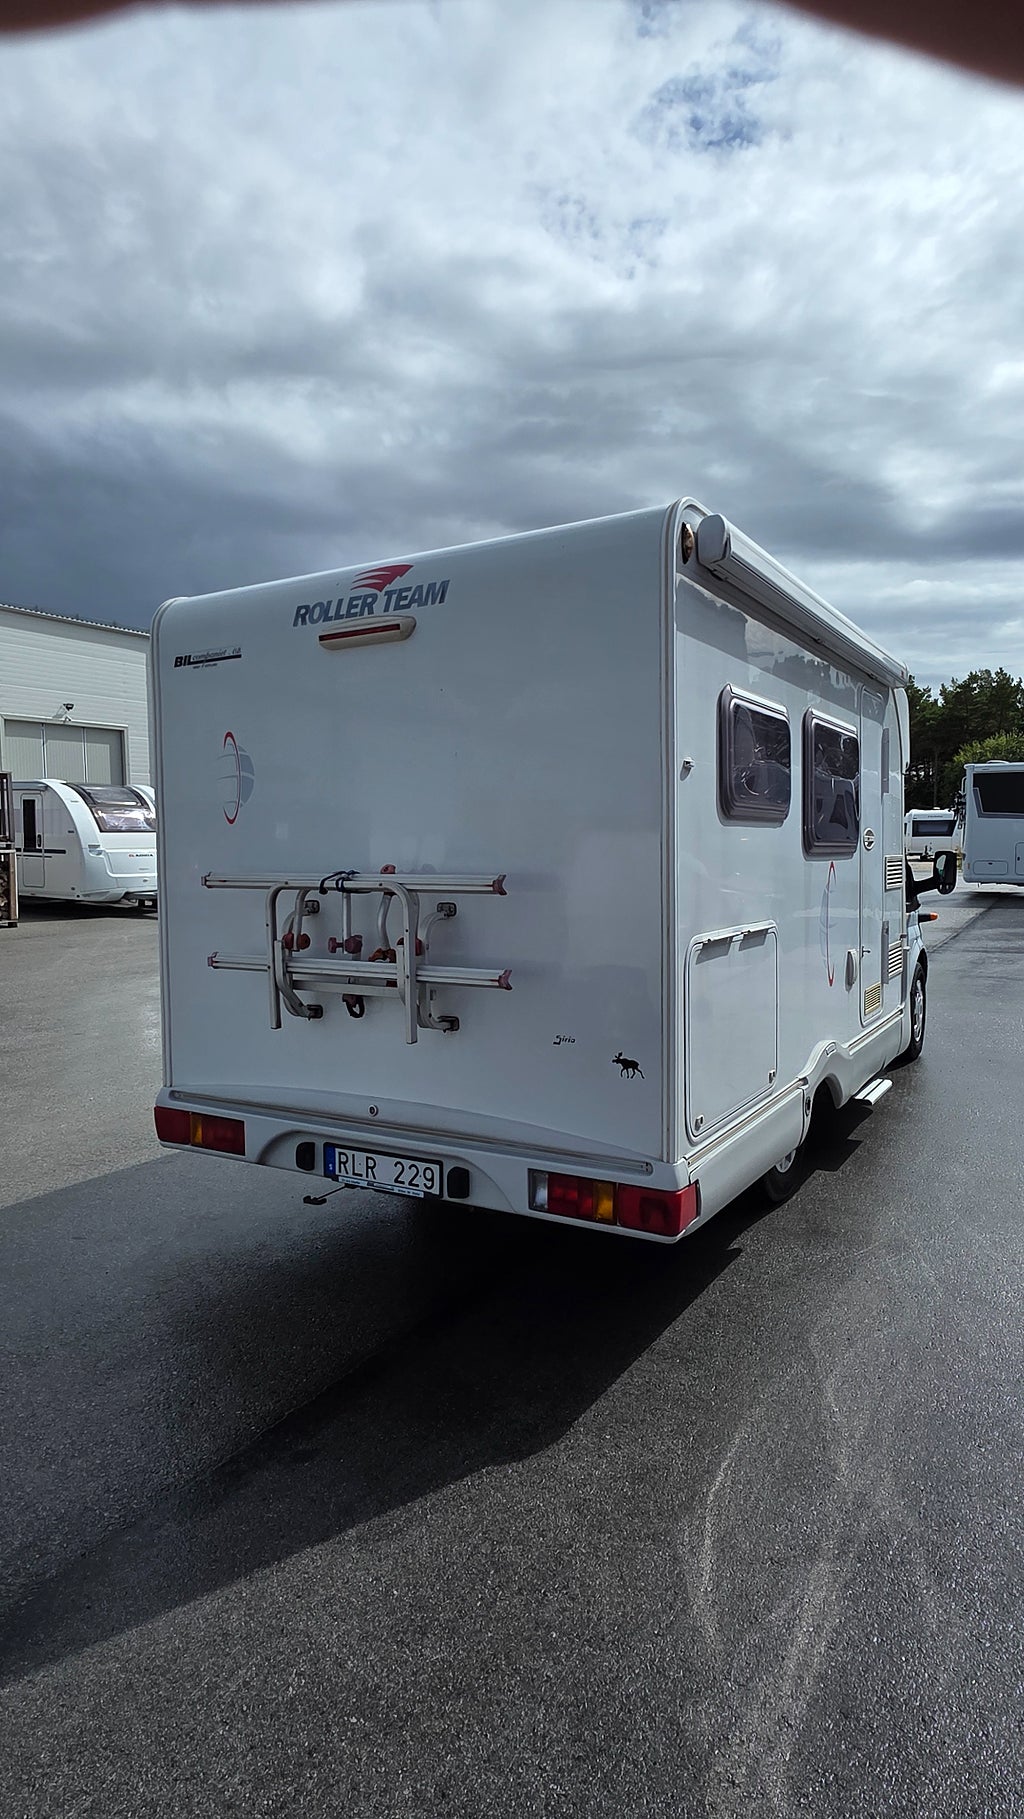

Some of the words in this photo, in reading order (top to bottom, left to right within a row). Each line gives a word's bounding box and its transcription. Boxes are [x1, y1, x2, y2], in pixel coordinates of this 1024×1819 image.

[293, 593, 378, 627] ROLLER
[383, 580, 450, 613] TEAM
[338, 1151, 377, 1180] RLR
[394, 1161, 434, 1190] 229
